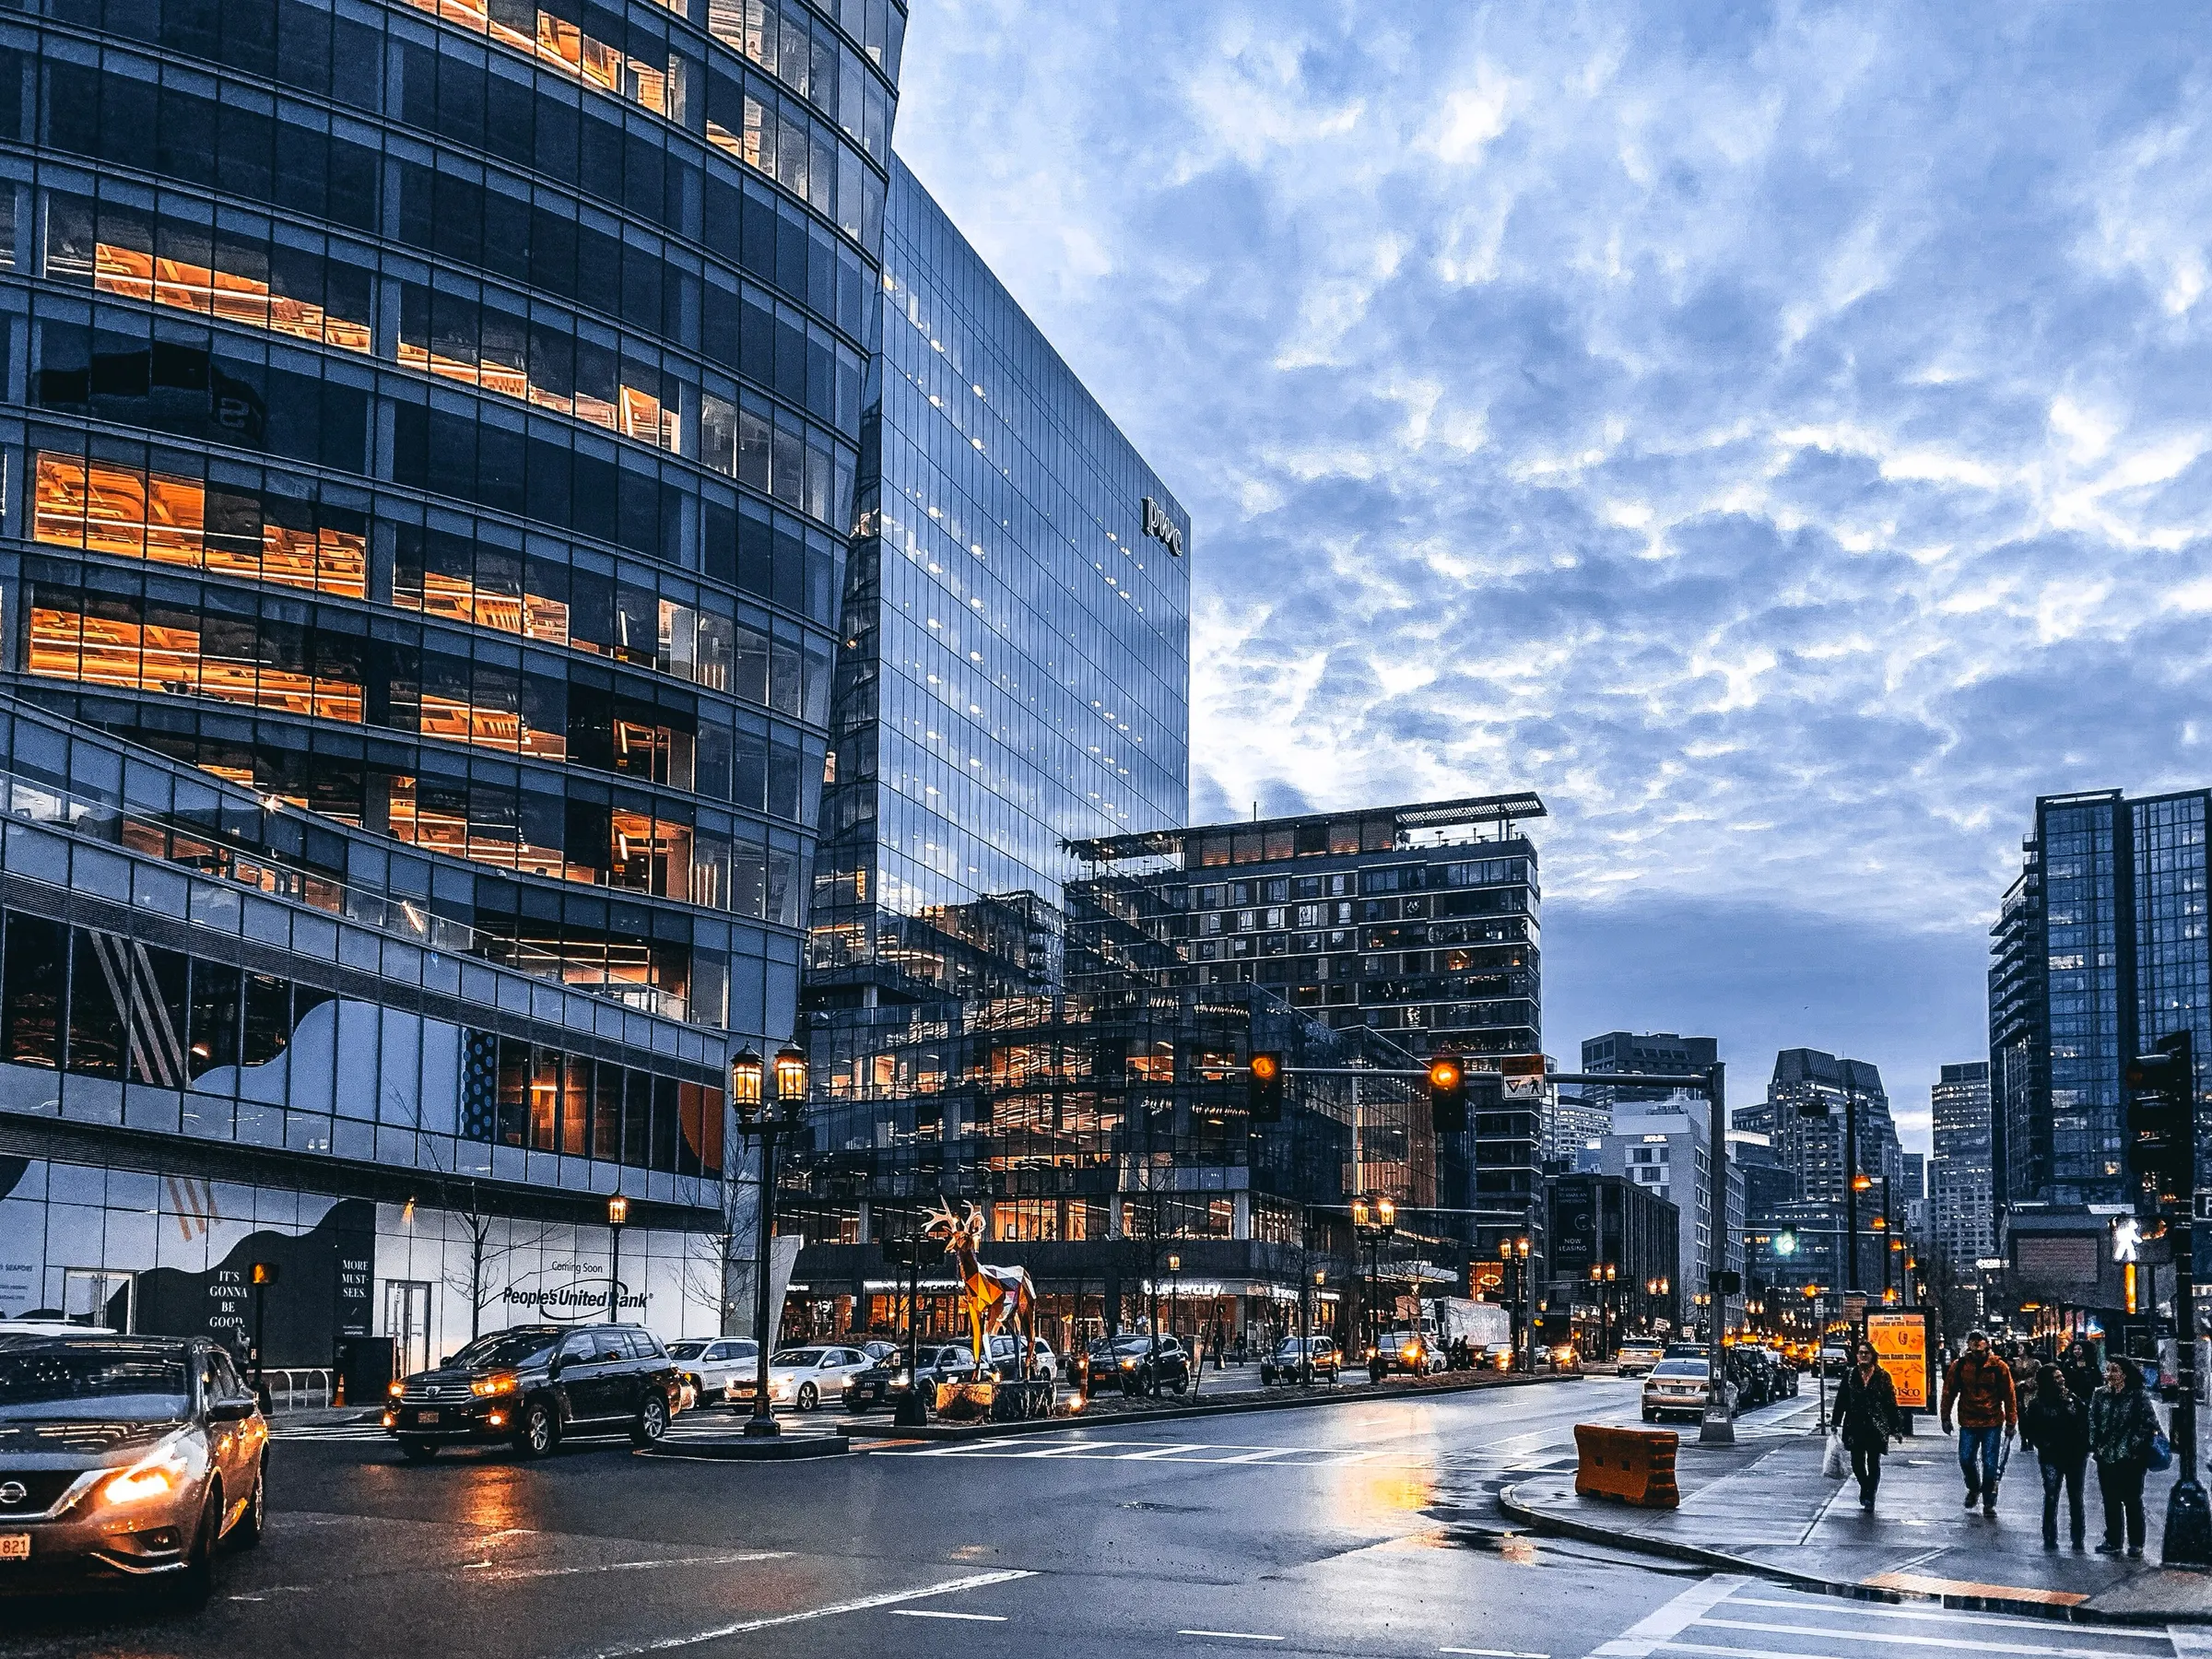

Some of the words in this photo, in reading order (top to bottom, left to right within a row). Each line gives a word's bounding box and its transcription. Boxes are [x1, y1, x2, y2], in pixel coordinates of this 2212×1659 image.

[1143, 497, 1182, 557] pwc
[343, 1259, 369, 1271] MORE
[551, 1261, 582, 1274] Coming
[582, 1263, 603, 1273] Soon
[219, 1270, 240, 1282] IT'S
[342, 1273, 369, 1284] MUST-
[209, 1285, 248, 1298] GONNA
[1143, 1279, 1223, 1299] buemercury
[502, 1287, 558, 1308] People's
[559, 1289, 606, 1307] United
[221, 1300, 235, 1312] BE
[3, 1539, 27, 1554] 821
